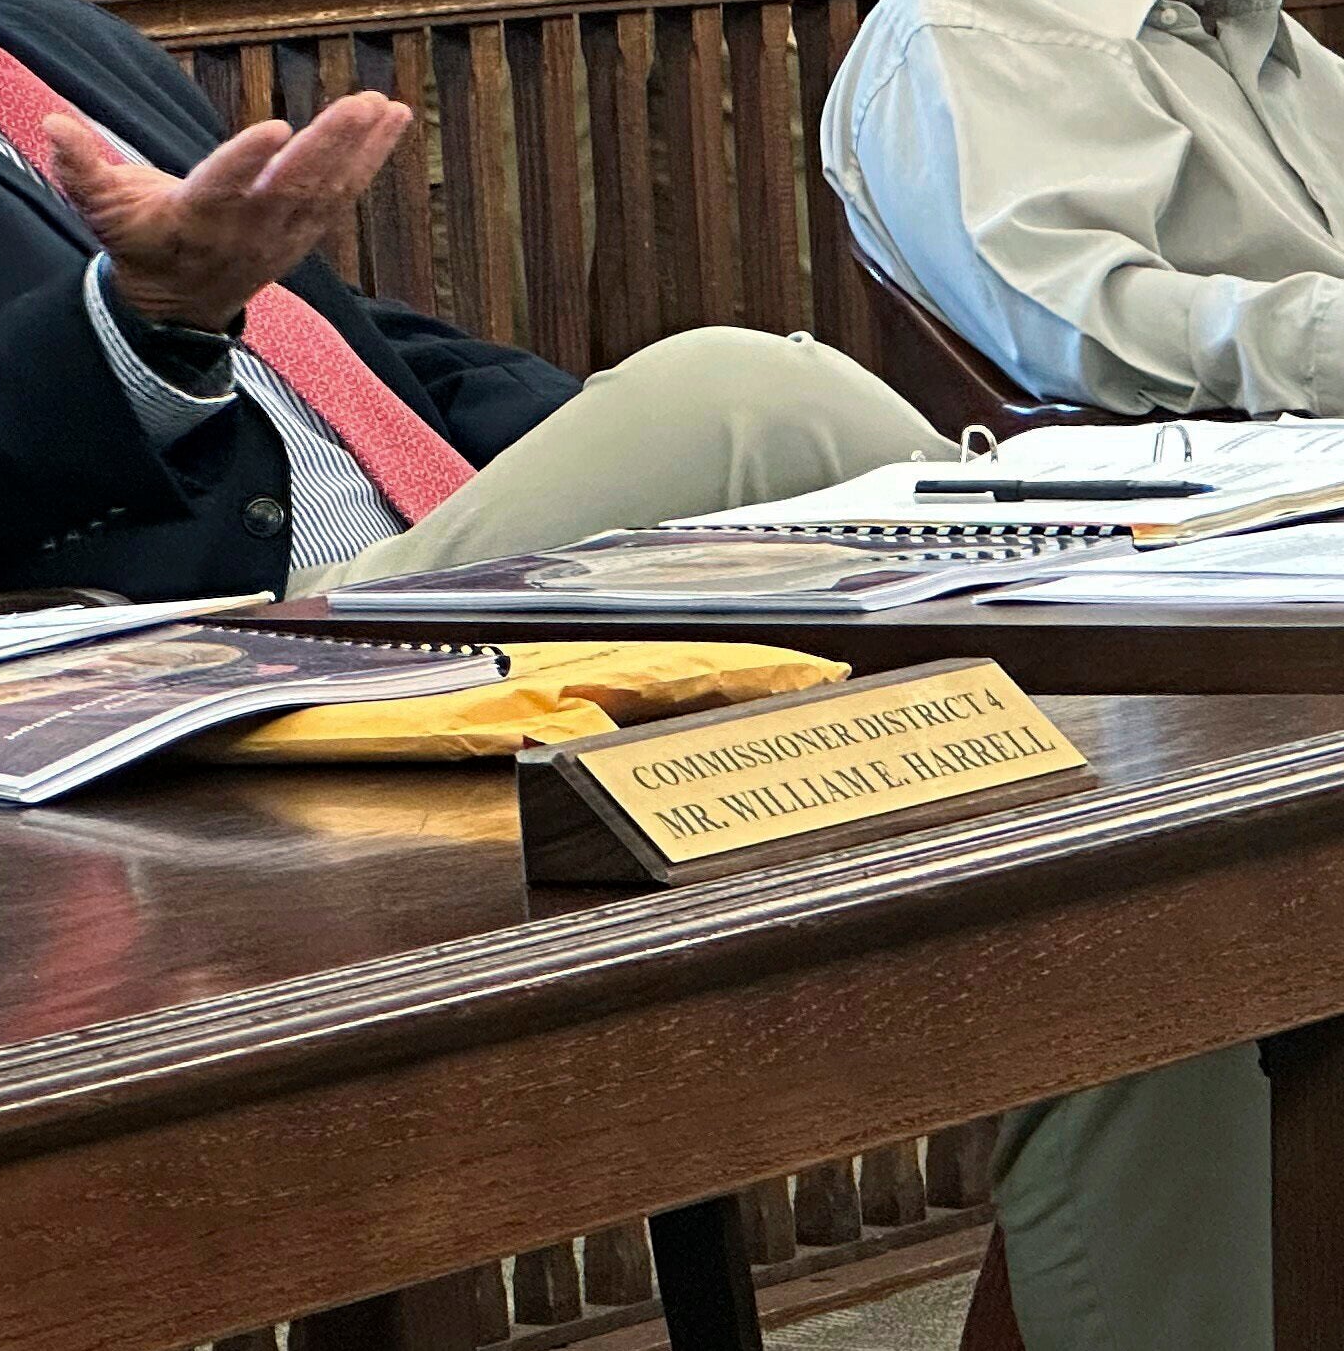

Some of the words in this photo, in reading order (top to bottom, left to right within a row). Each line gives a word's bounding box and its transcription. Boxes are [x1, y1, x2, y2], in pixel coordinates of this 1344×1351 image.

[632, 723, 860, 790] COMMISSIONER
[851, 692, 986, 740] DISTRICT
[983, 688, 1006, 710] 4
[653, 803, 730, 840] MR.
[715, 766, 879, 822] WILLIAM
[866, 760, 911, 789] E.
[899, 725, 1056, 781] HARRELL
